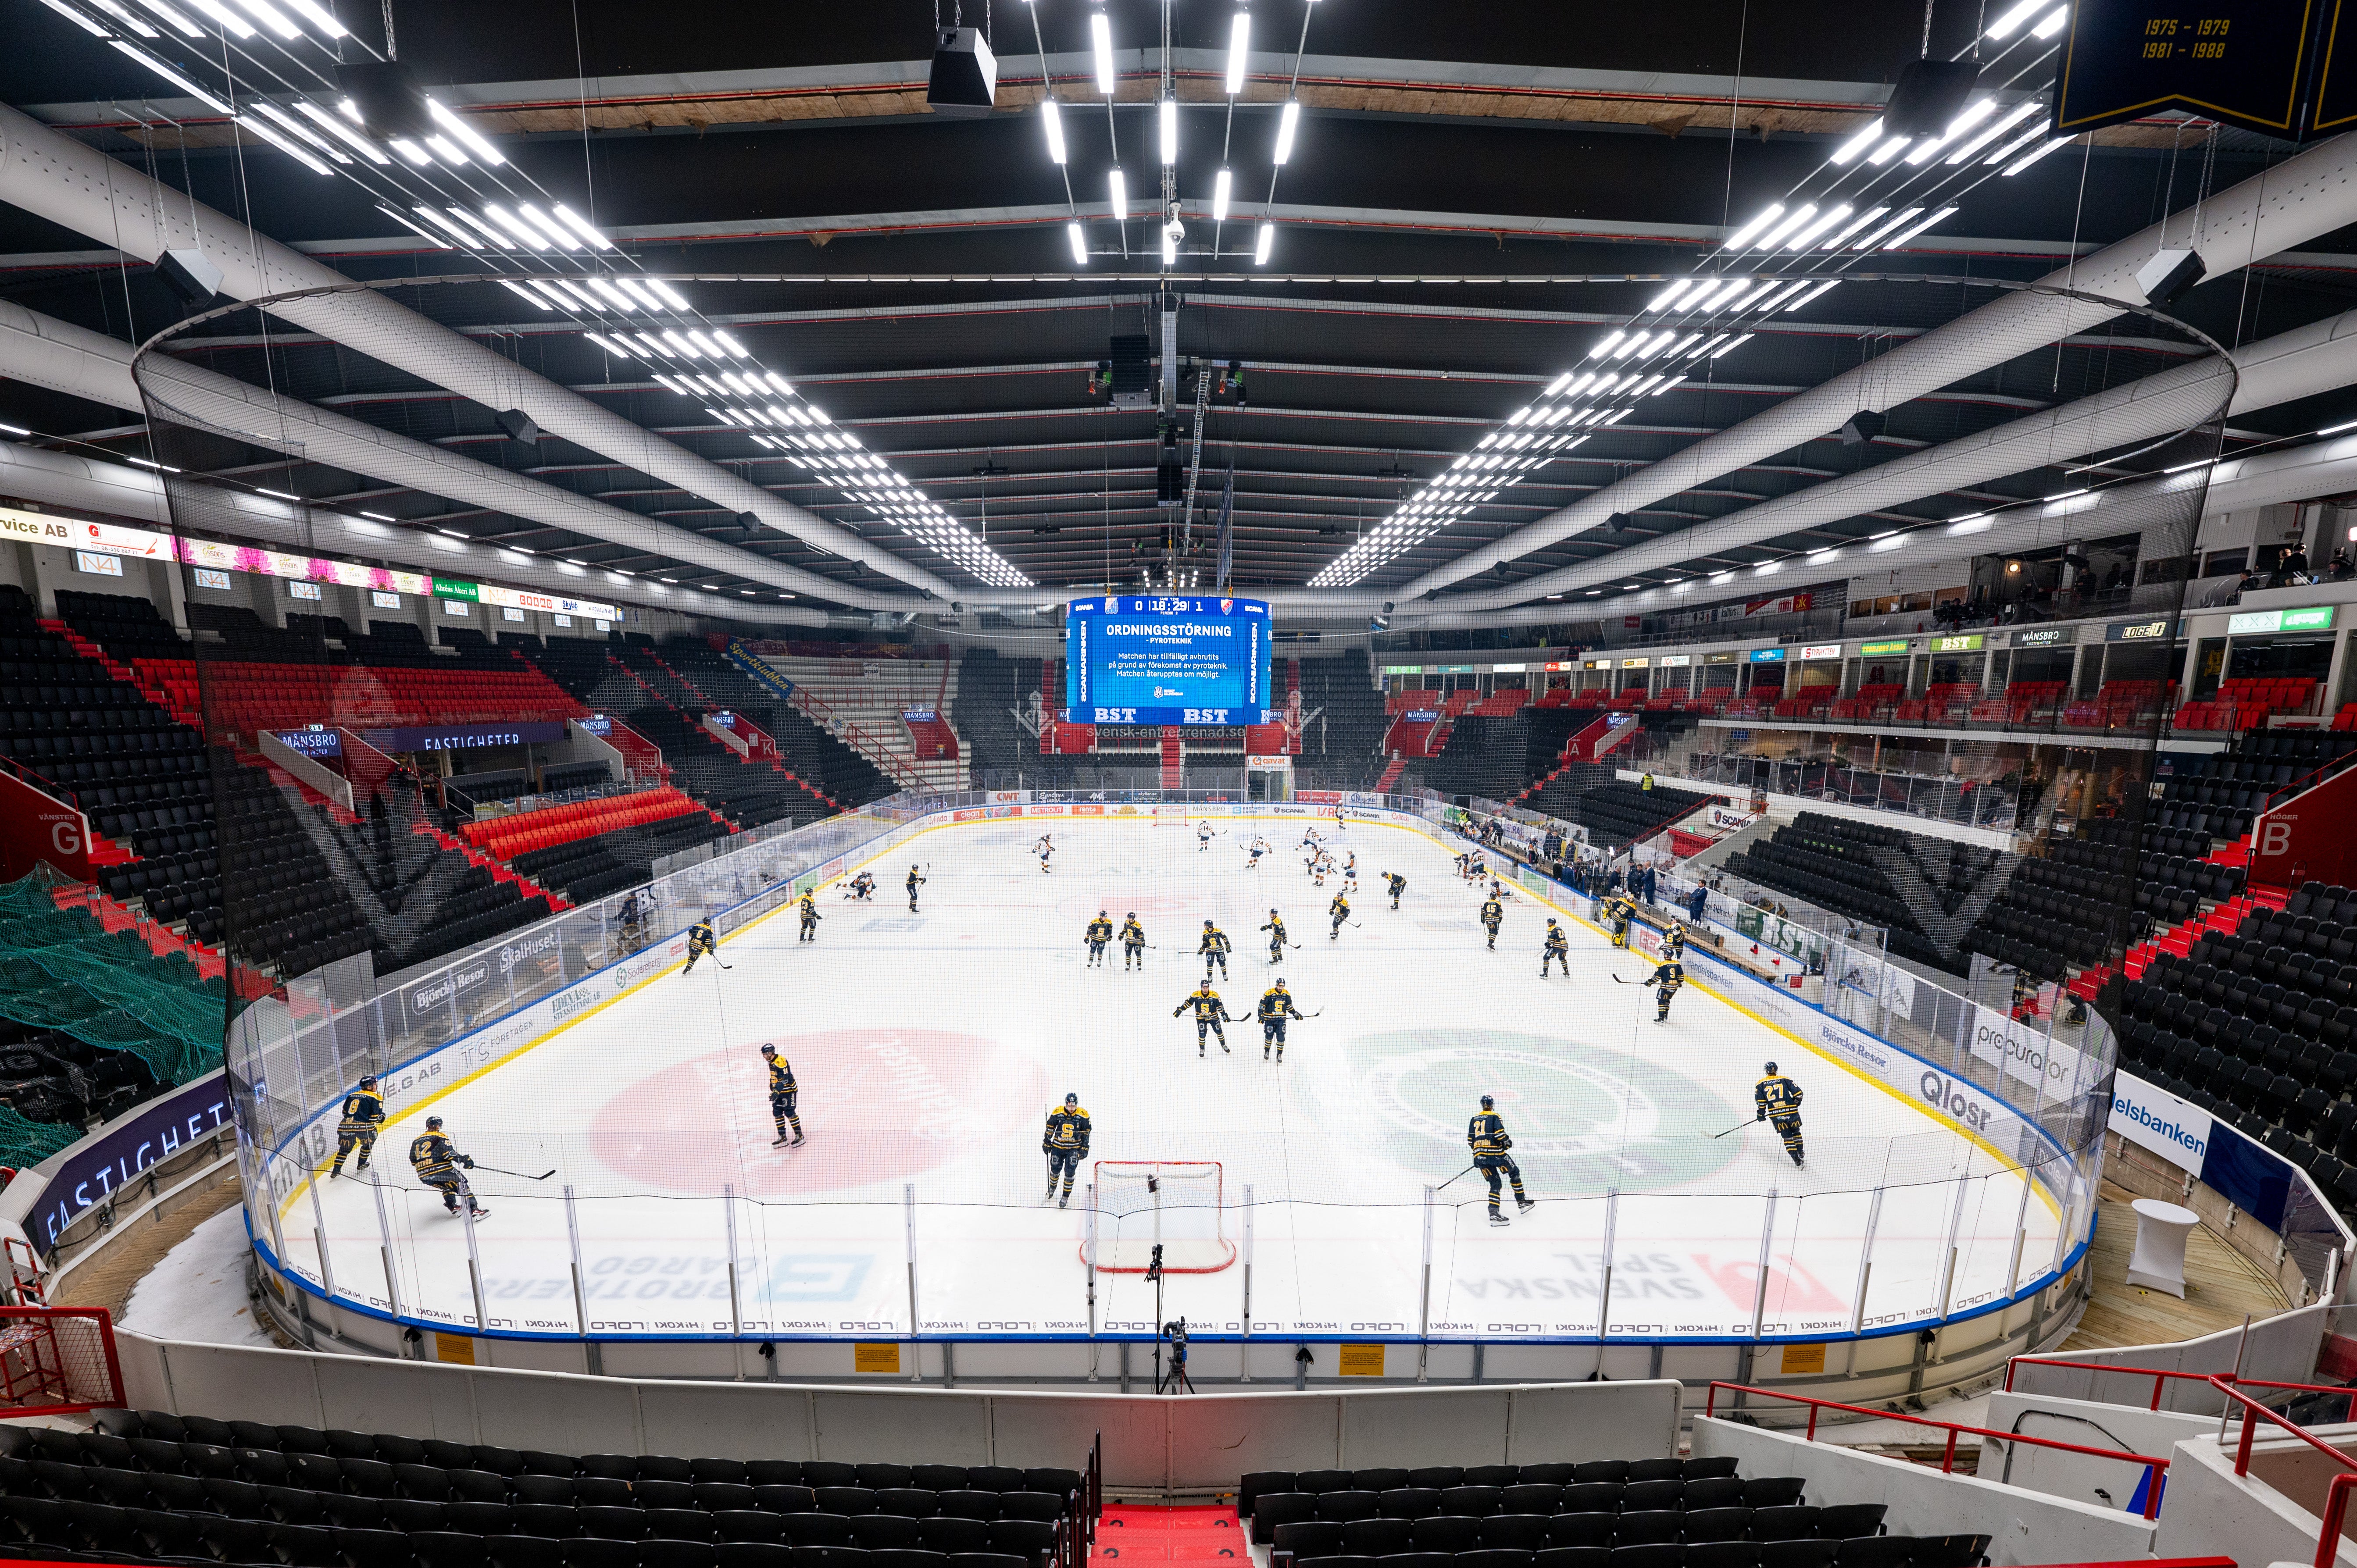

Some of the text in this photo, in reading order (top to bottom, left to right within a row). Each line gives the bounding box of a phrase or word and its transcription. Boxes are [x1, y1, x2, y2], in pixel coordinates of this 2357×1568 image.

[2145, 19, 2178, 36] 1975
[2197, 19, 2230, 36] 1979
[2142, 43, 2172, 58] 1981
[2192, 43, 2225, 58] 1988
[45, 524, 68, 538] AB
[82, 554, 116, 574] N4
[199, 571, 226, 587] N4
[294, 584, 317, 598] N4
[436, 584, 453, 593] Ahréns
[454, 584, 467, 595] Åkeri
[376, 593, 396, 606] N4
[1135, 601, 1143, 610] 0
[1152, 601, 1186, 611] 18:29
[1196, 602, 1203, 611] 1
[448, 602, 465, 613] N4
[1107, 623, 1232, 637] ORDNINGSSTÖRNING
[2022, 631, 2059, 641] MÅNSBRO
[1941, 637, 1970, 649] BST
[1161, 653, 1188, 661] tillfälligt
[1806, 648, 1836, 658] STYRHYTTEN
[729, 643, 789, 690] Sportklubben
[1193, 662, 1228, 670] pyroteknik.
[1146, 670, 1183, 678] återupptas
[1196, 670, 1220, 679] möjligt.
[1095, 708, 1136, 721] BST
[1184, 709, 1228, 722] BST
[580, 720, 609, 730] MÅNSBRO
[283, 733, 336, 748] MÅNSBRO
[763, 741, 773, 755] K
[1569, 743, 1579, 755] A
[997, 792, 1019, 801] CWT
[928, 815, 947, 825] Cylinda
[1392, 813, 1410, 822] Cylinda
[1721, 815, 1751, 827] SCANIA
[52, 822, 80, 855] G
[2261, 823, 2292, 855] B
[1486, 904, 1496, 912] 45
[1617, 903, 1628, 912] 35
[696, 929, 704, 938] 6
[1761, 914, 1819, 962] BST
[627, 957, 661, 980] Söderenergi
[1669, 966, 1675, 976] 9
[416, 966, 486, 1009] Björcks Resor
[489, 1019, 534, 1048] FÖRETAGEN
[1822, 1026, 1886, 1068] Björcks Resor
[418, 1062, 442, 1082] AB
[1765, 1083, 1783, 1101] 27
[347, 1099, 360, 1114] 8
[1921, 1070, 1991, 1131] Qlosr
[1474, 1119, 1485, 1138] 21
[415, 1140, 431, 1160] 12
[592, 1257, 761, 1275] CARGO
[1551, 1254, 1681, 1272] SPEL
[462, 1278, 742, 1299] BROTHERS
[1456, 1277, 1705, 1300] SVENSKA
